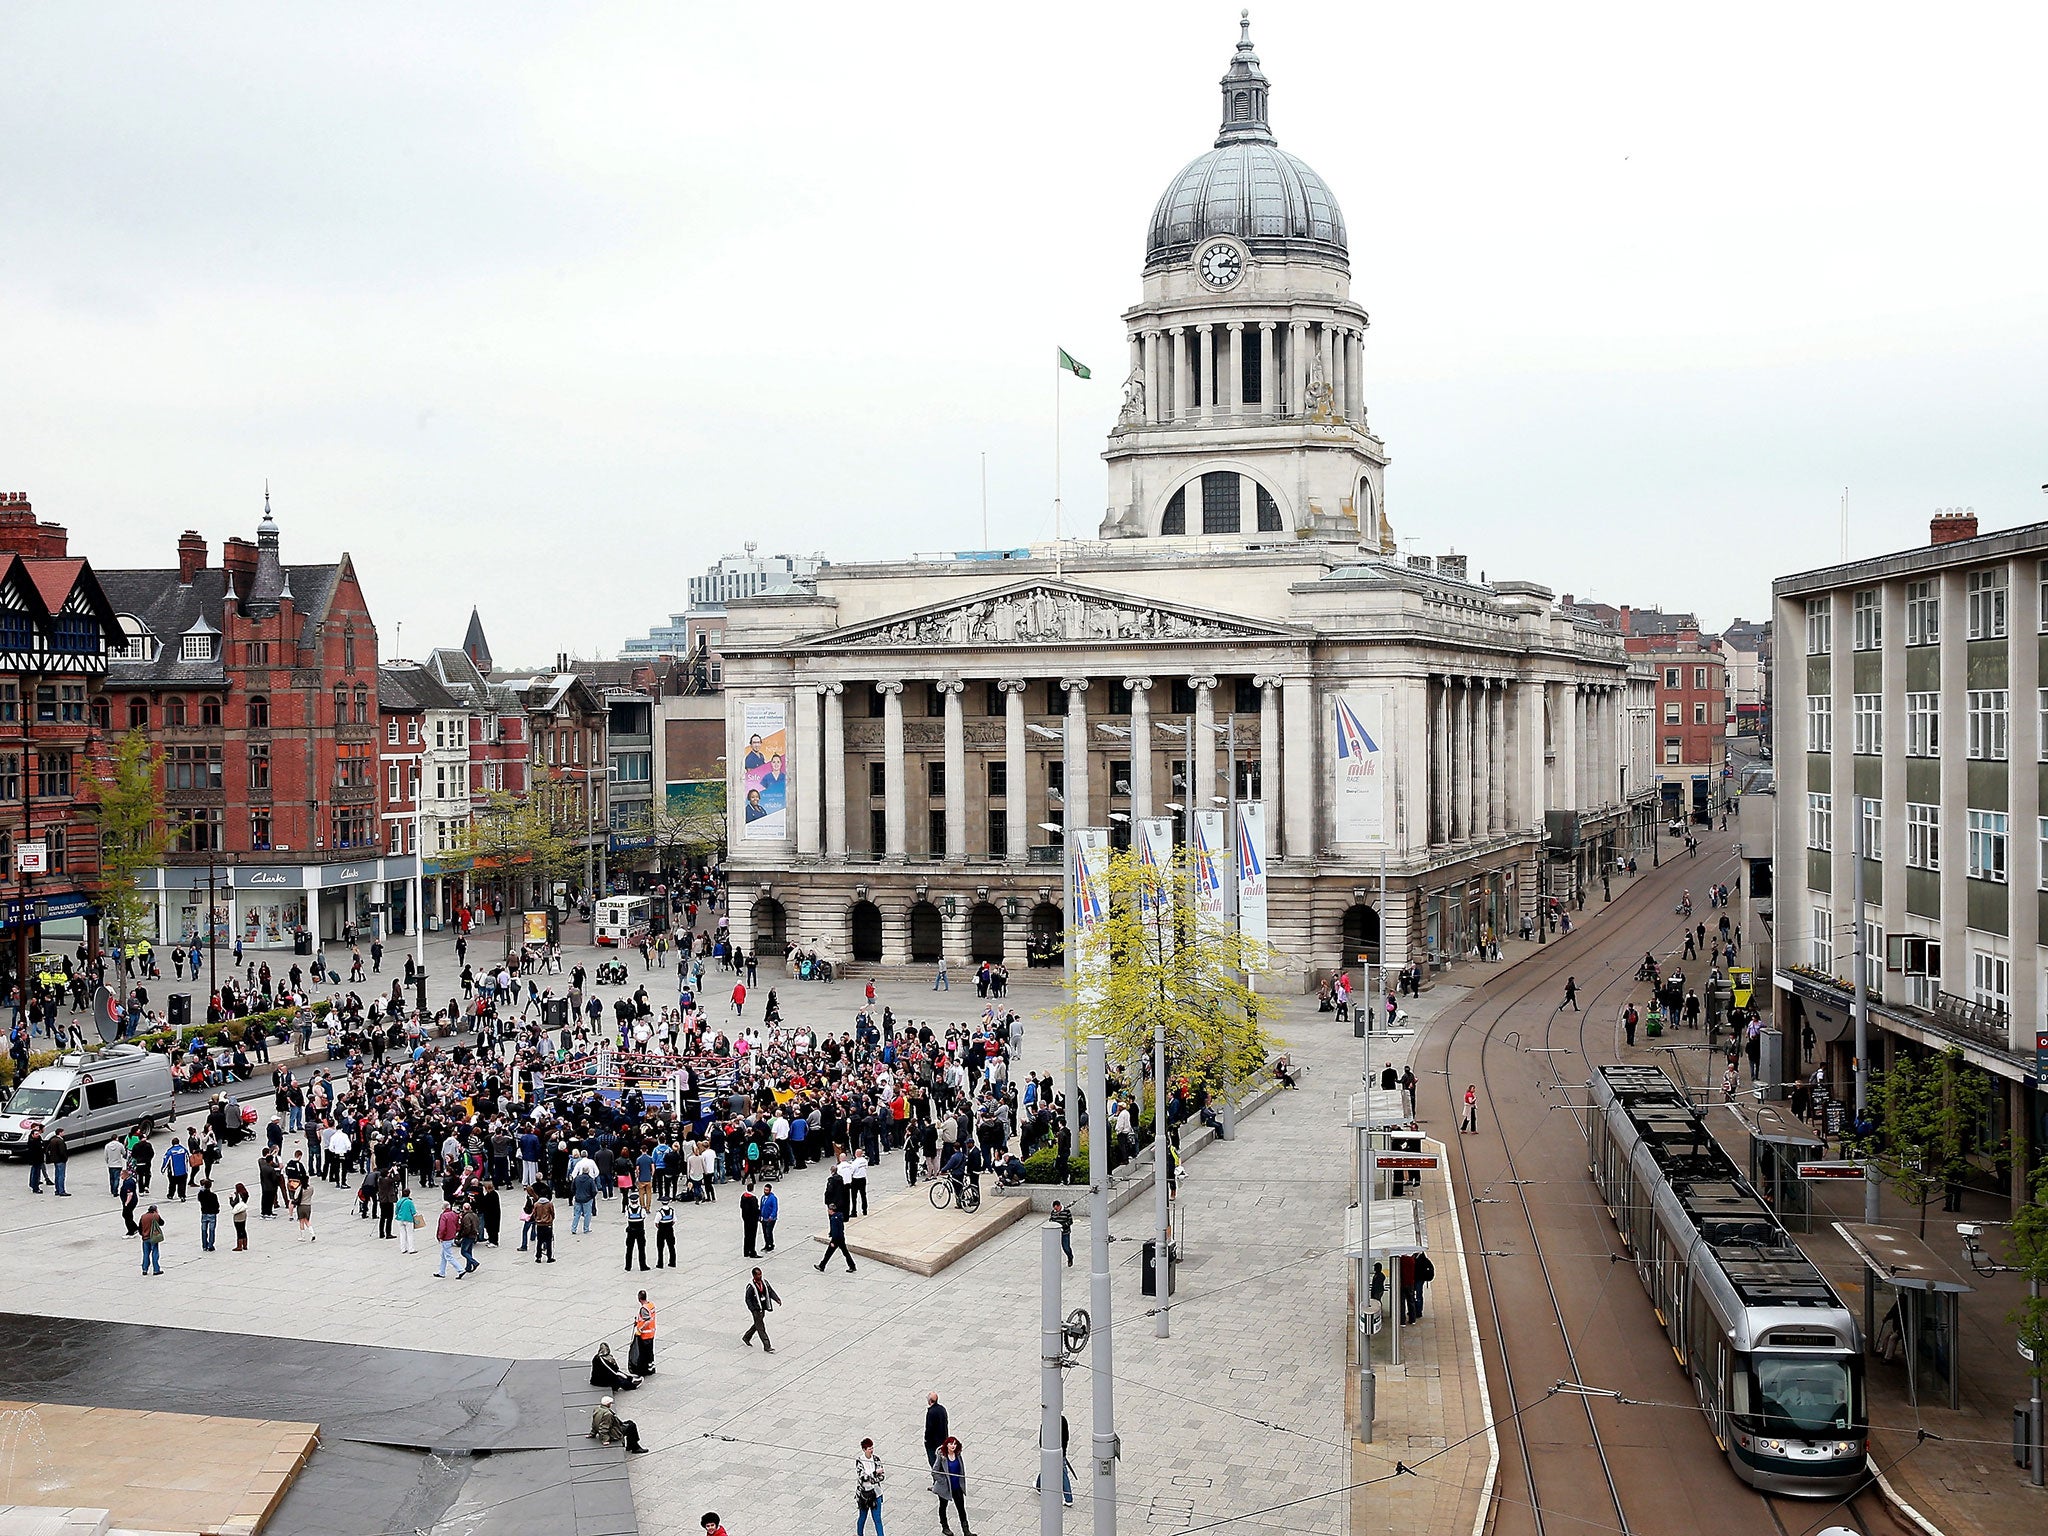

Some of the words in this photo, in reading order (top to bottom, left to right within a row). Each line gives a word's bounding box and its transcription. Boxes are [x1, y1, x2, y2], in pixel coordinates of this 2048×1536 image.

[1348, 760, 1375, 775] milk
[250, 872, 286, 883] Clarks
[340, 868, 359, 879] Clarks
[1244, 883, 1264, 895] milk
[11, 903, 34, 912] BROK
[1200, 898, 1222, 911] milk
